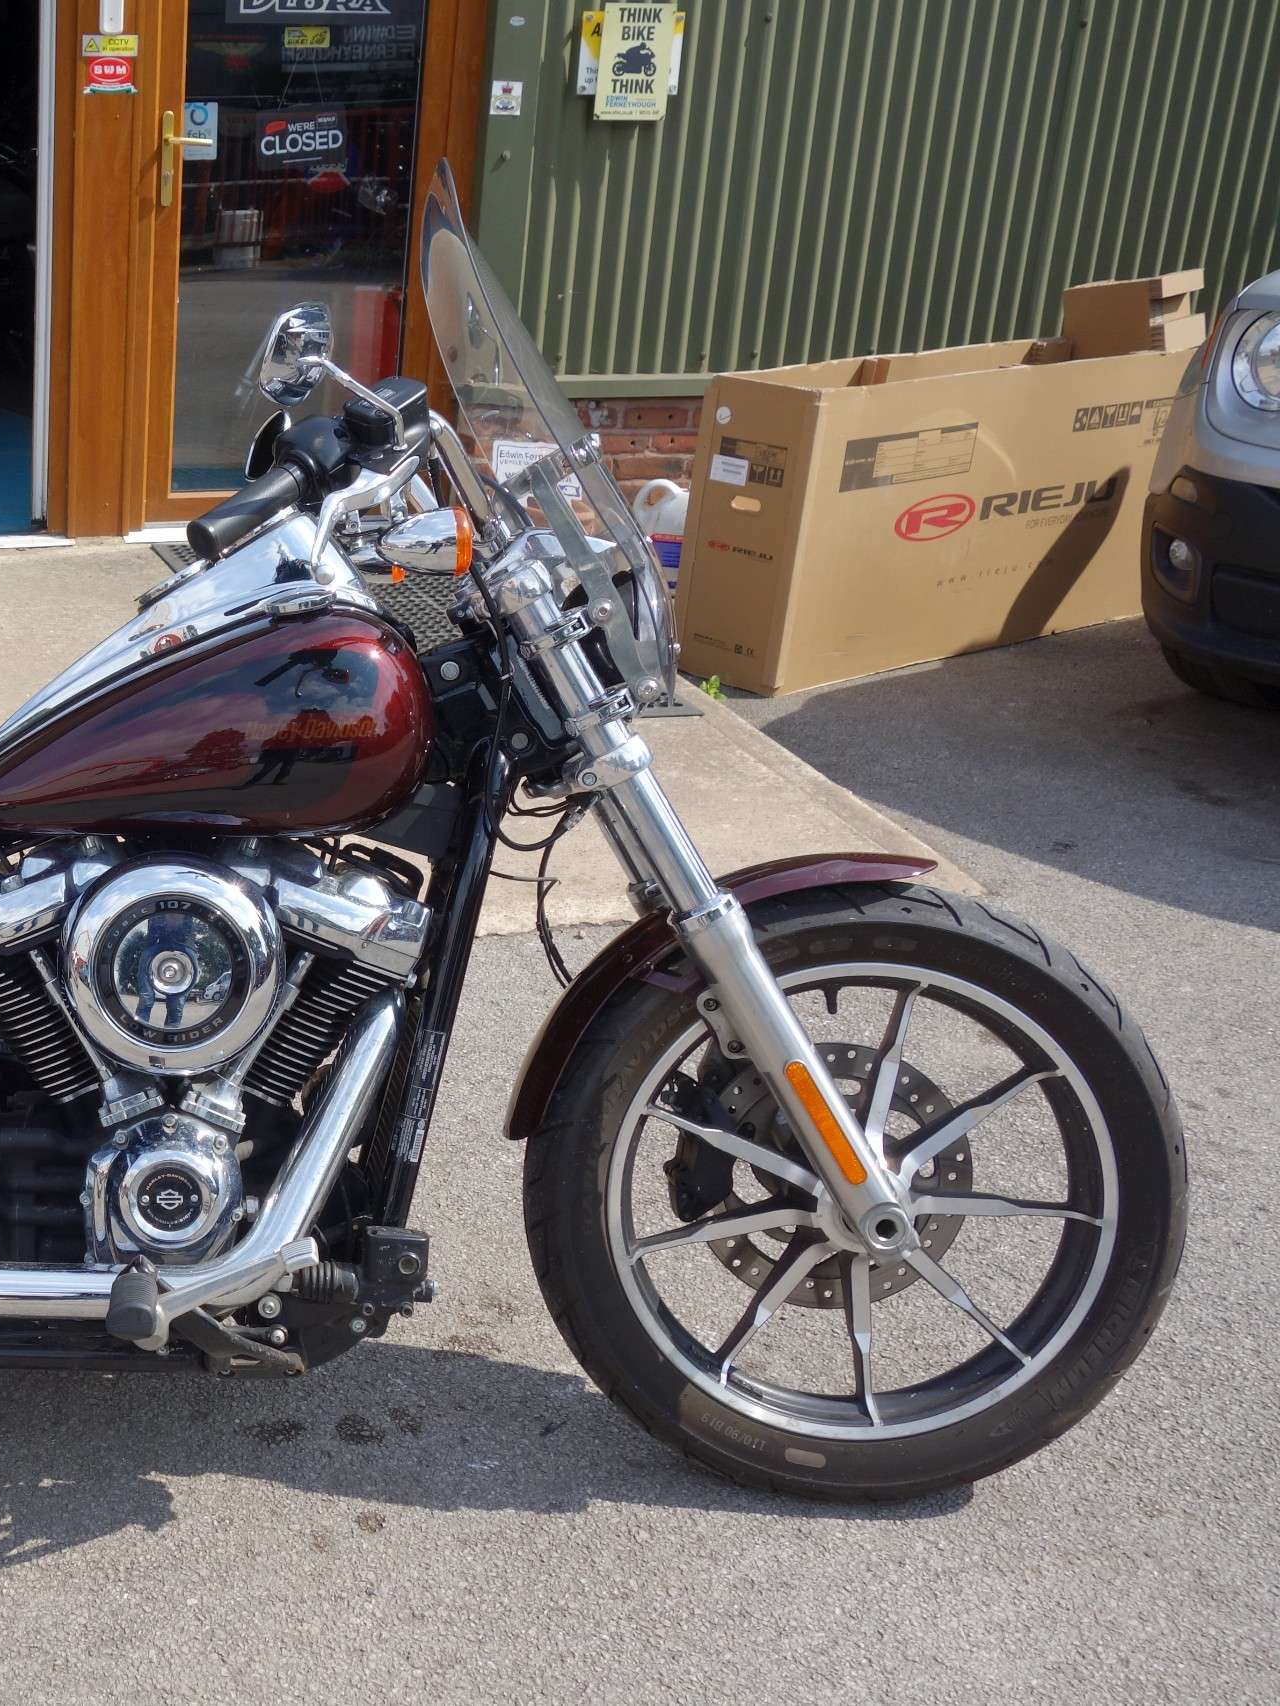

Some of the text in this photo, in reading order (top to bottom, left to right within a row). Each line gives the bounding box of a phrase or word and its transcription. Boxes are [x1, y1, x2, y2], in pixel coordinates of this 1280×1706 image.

[620, 8, 663, 23] THINK
[621, 26, 656, 41] BIKE
[611, 79, 655, 94] THINK
[260, 130, 344, 156] CLOSED
[979, 477, 1118, 521] RIEJU
[159, 901, 192, 910] 107
[120, 1014, 224, 1042] LOW RIDER
